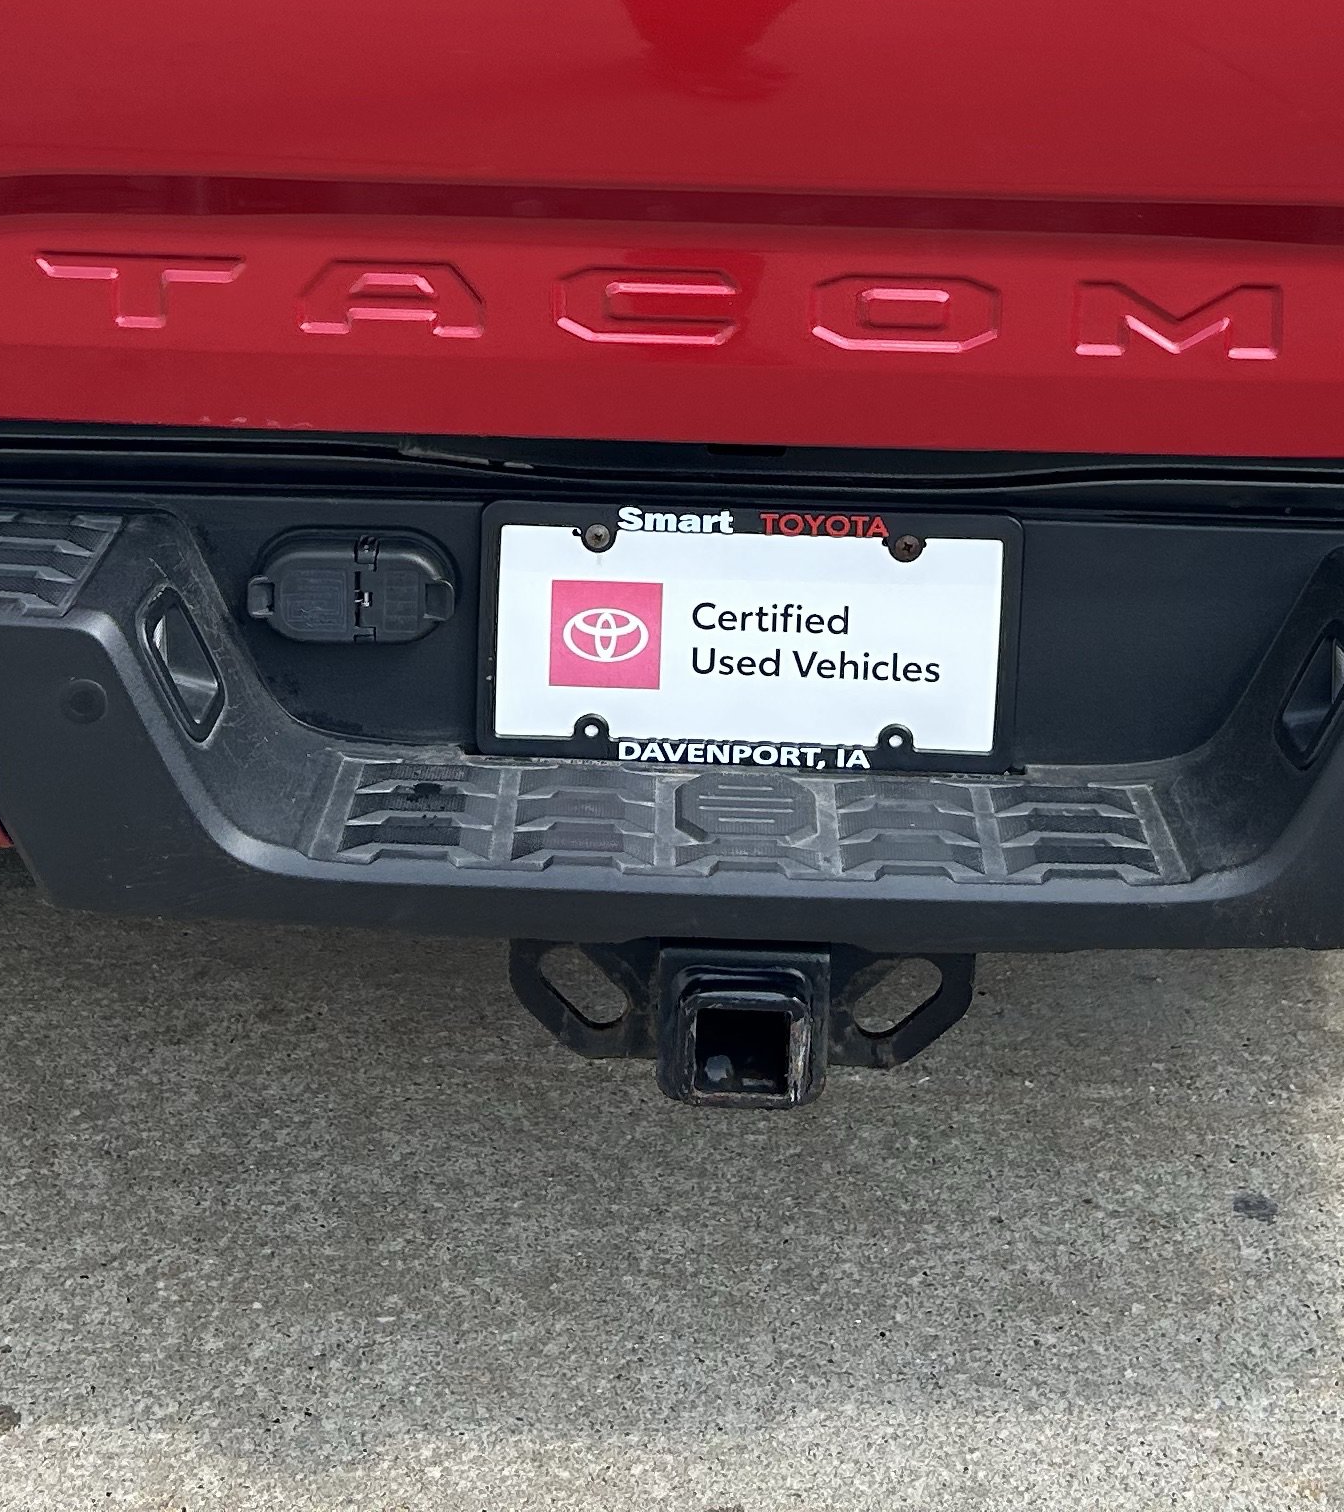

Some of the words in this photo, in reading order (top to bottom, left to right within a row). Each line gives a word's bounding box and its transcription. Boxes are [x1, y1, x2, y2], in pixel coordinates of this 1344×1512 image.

[616, 507, 735, 534] Smart
[759, 512, 889, 538] TOYOTA
[692, 602, 850, 636] Certified
[692, 647, 781, 678] Used
[792, 650, 941, 684] Vehicles
[617, 741, 827, 770] DAVENPORT,
[836, 744, 871, 769] IA
